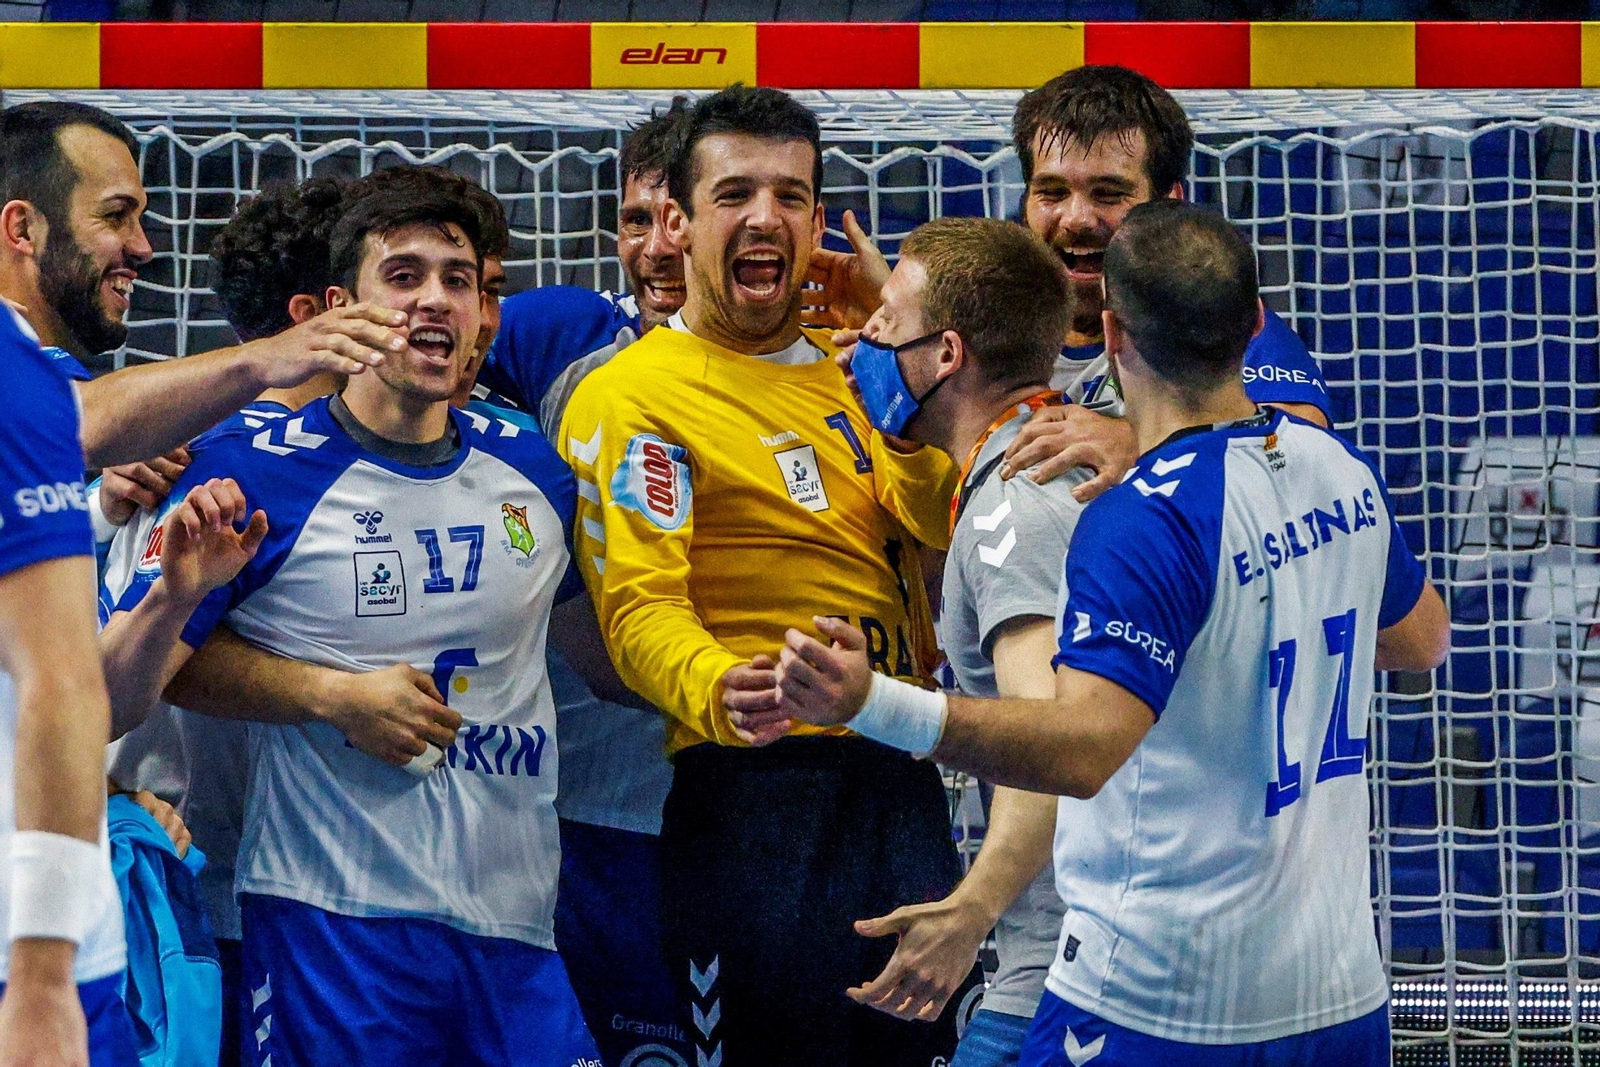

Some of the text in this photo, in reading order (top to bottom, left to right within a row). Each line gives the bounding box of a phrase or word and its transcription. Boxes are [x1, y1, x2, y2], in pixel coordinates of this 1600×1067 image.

[620, 42, 727, 64] elan
[1242, 365, 1325, 394] SOREA
[789, 480, 820, 495] sacyr
[798, 493, 820, 504] asobal
[355, 533, 393, 544] hummel
[414, 525, 484, 593] 17
[360, 584, 403, 597] sacyr
[367, 597, 397, 605] asobal
[1104, 620, 1176, 674] SOREA
